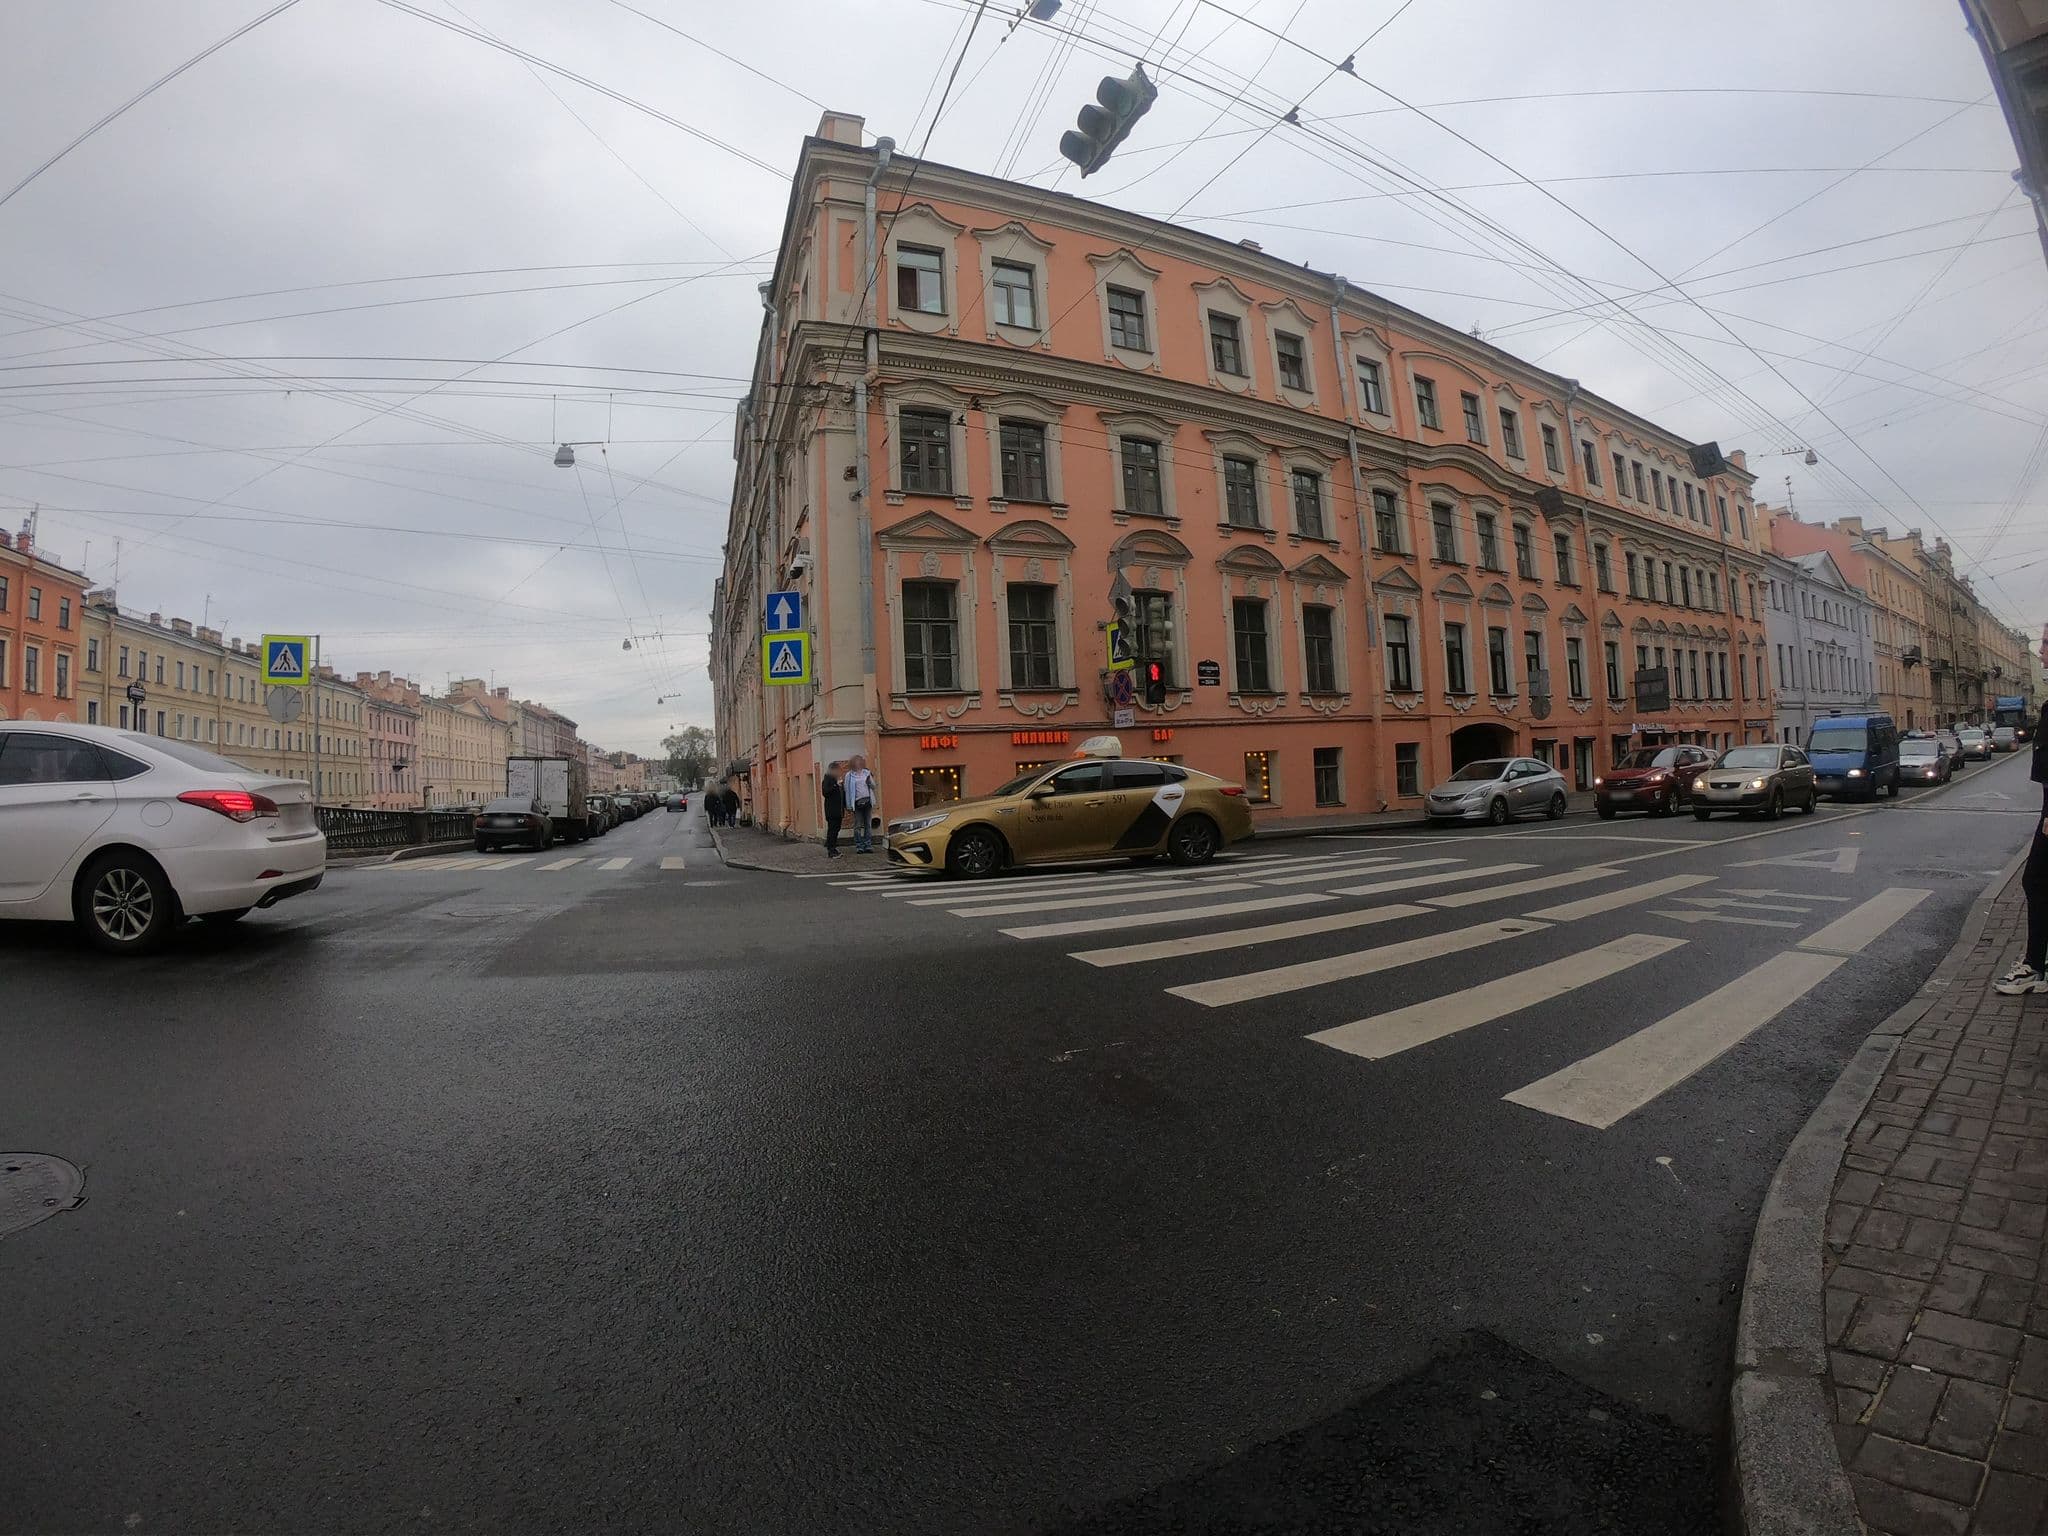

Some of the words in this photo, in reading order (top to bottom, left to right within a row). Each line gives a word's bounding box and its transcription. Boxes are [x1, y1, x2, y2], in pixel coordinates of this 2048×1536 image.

[1012, 731, 1070, 745] КИЛИКИЯ
[1153, 728, 1174, 741] БАР
[921, 735, 958, 749] КАФЕ
